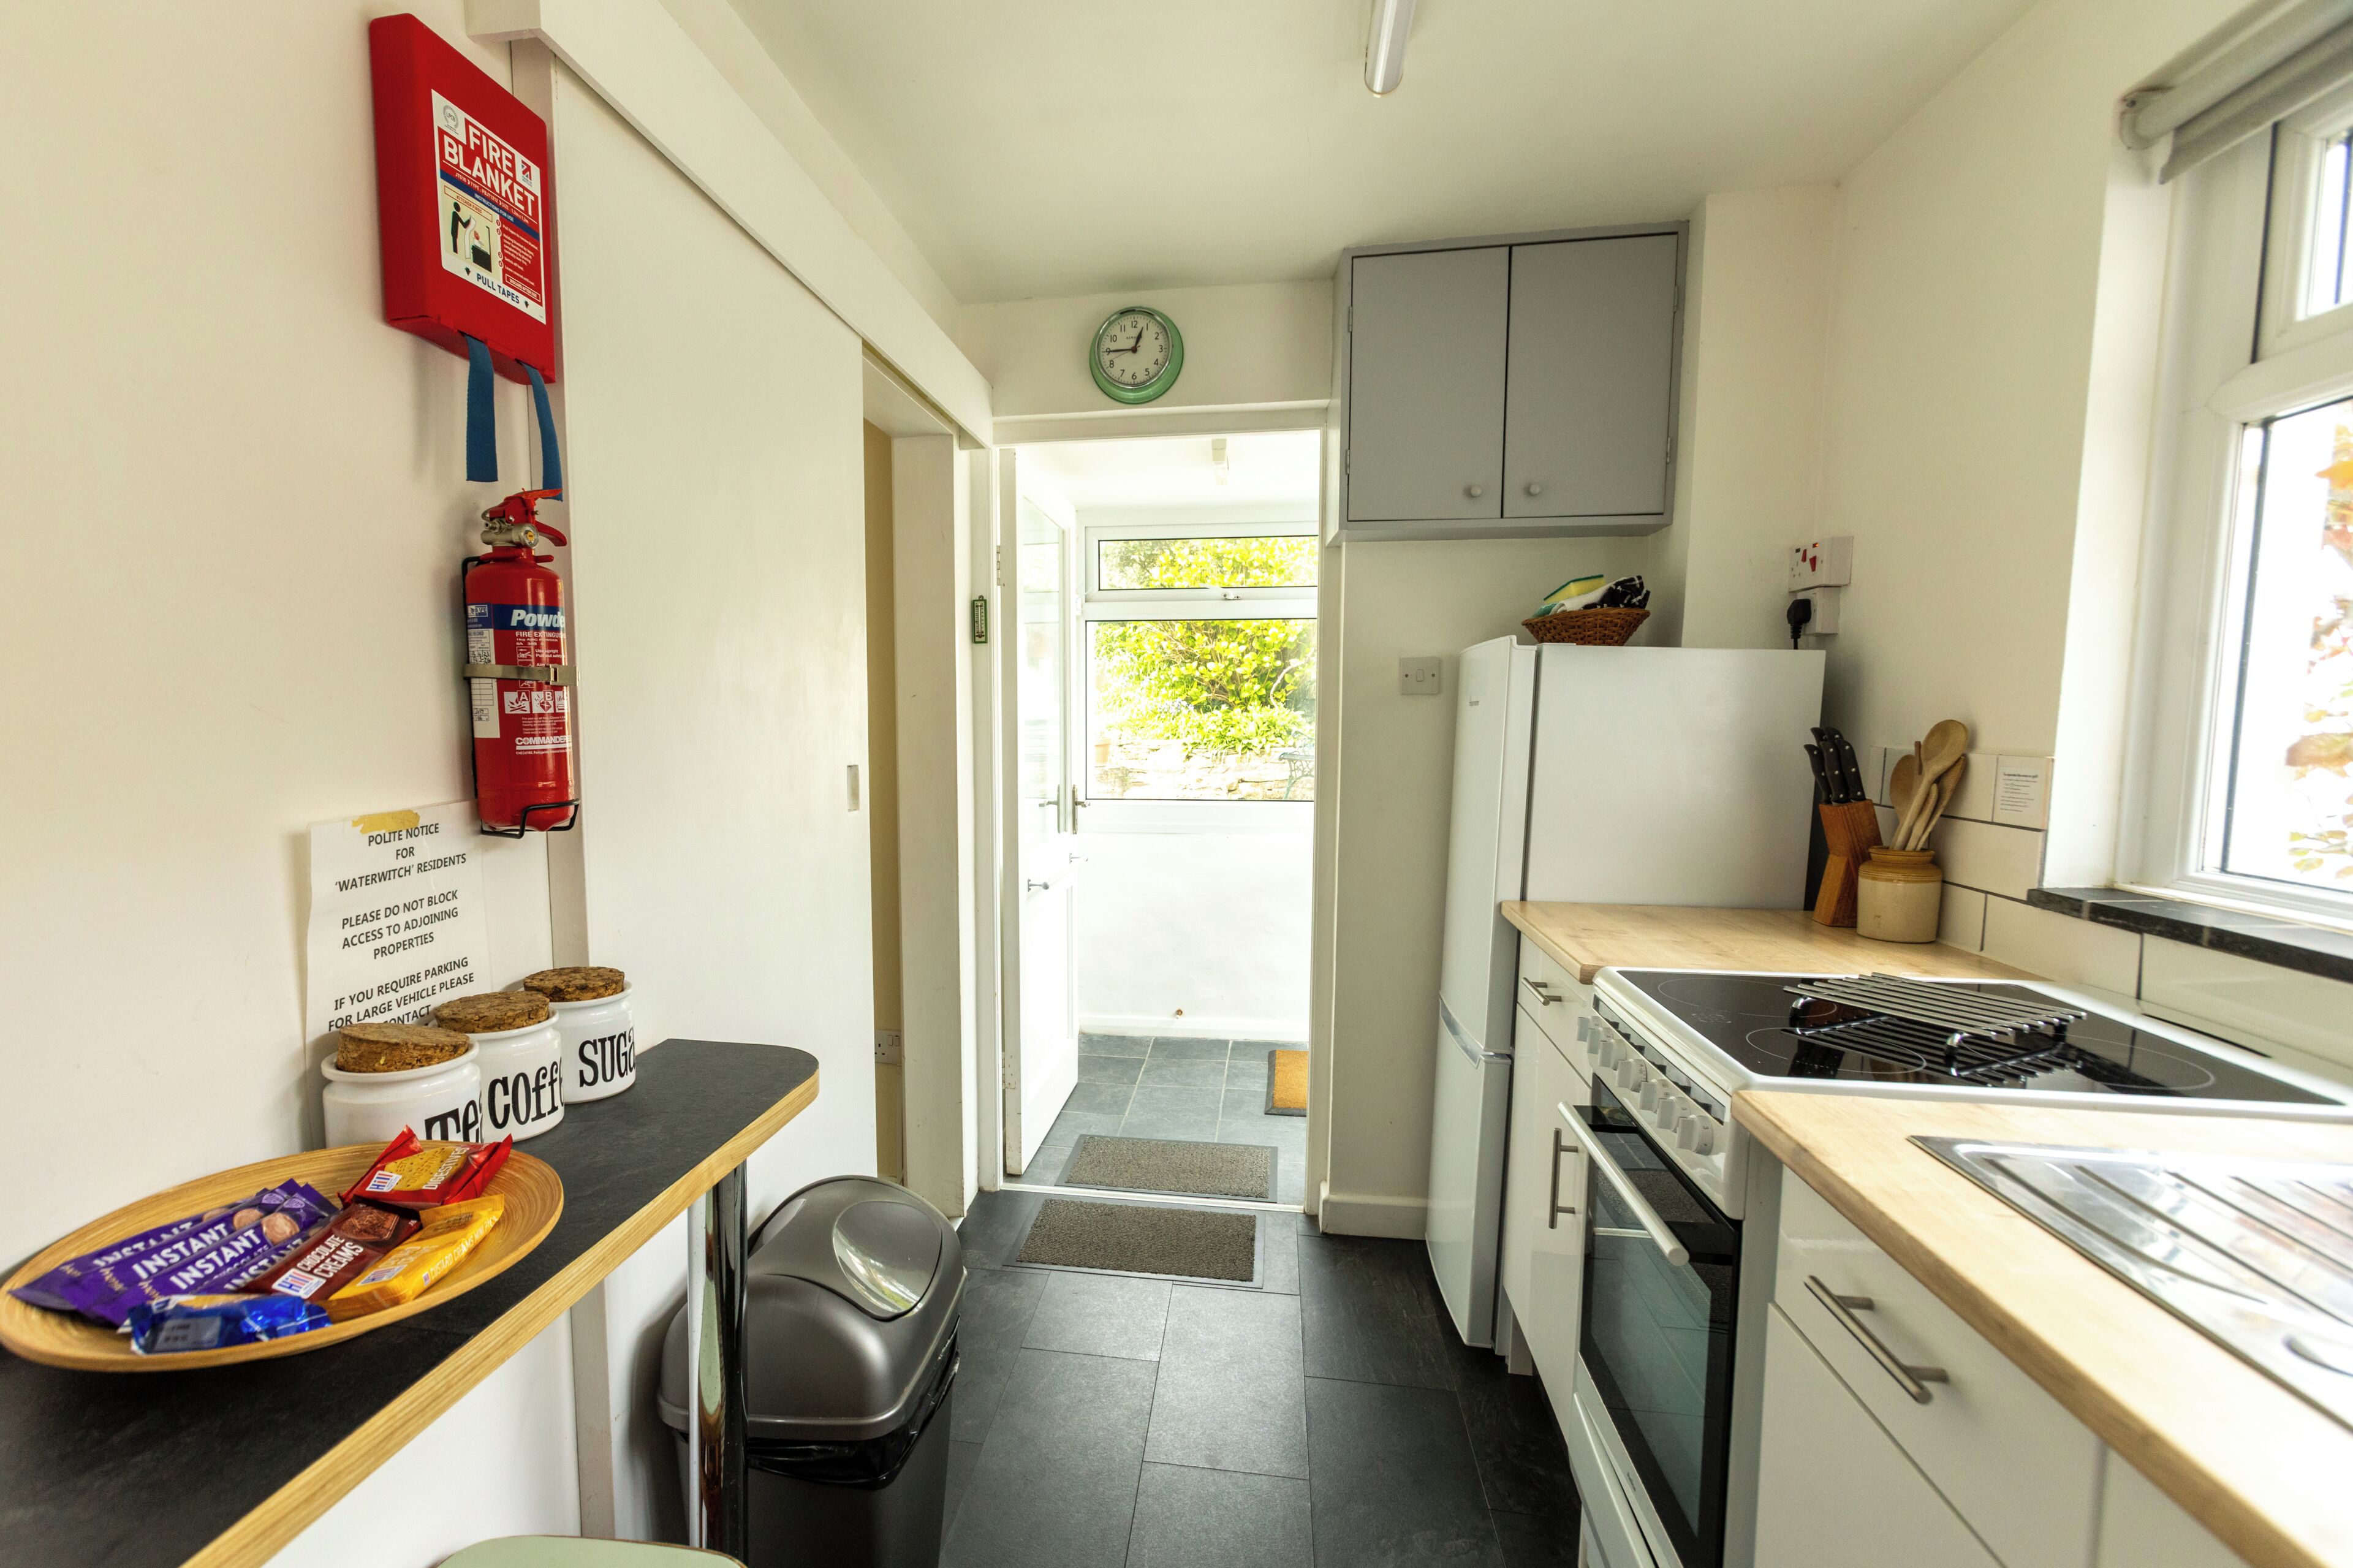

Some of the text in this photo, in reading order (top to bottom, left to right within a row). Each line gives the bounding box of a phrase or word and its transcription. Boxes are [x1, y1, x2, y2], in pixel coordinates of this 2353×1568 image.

[468, 124, 513, 176] FIRE
[444, 134, 535, 218] BLANKET
[457, 195, 482, 213] KITCHEN FIRES
[474, 193, 499, 212] INSTRUCTIONS
[477, 273, 519, 303] PULL TAPES
[520, 692, 528, 701] A
[545, 692, 552, 700] B
[368, 823, 439, 846] POLITE NOTICE
[396, 846, 415, 860] FOR
[417, 853, 466, 874] RESIDENTS
[341, 890, 458, 930] PLEASE DO NOT BLOCK
[342, 907, 458, 949] ACCESS TO ADJOINING
[373, 932, 434, 960] PROPERTIES
[334, 956, 469, 1010] IF YOU REQUIRE PARKING
[328, 972, 474, 1032] FOR LARGE VEHICLE PLEASE
[369, 1173, 393, 1190] Hill
[422, 1146, 469, 1190] DIGESTIVES
[132, 1223, 229, 1279] INSTANT
[169, 1229, 261, 1290] INSTANT
[297, 1234, 346, 1272] CHOCOLATE
[313, 1241, 364, 1279] CREAMS
[430, 1253, 453, 1280] CUSTARD
[278, 1271, 314, 1293] Hill
